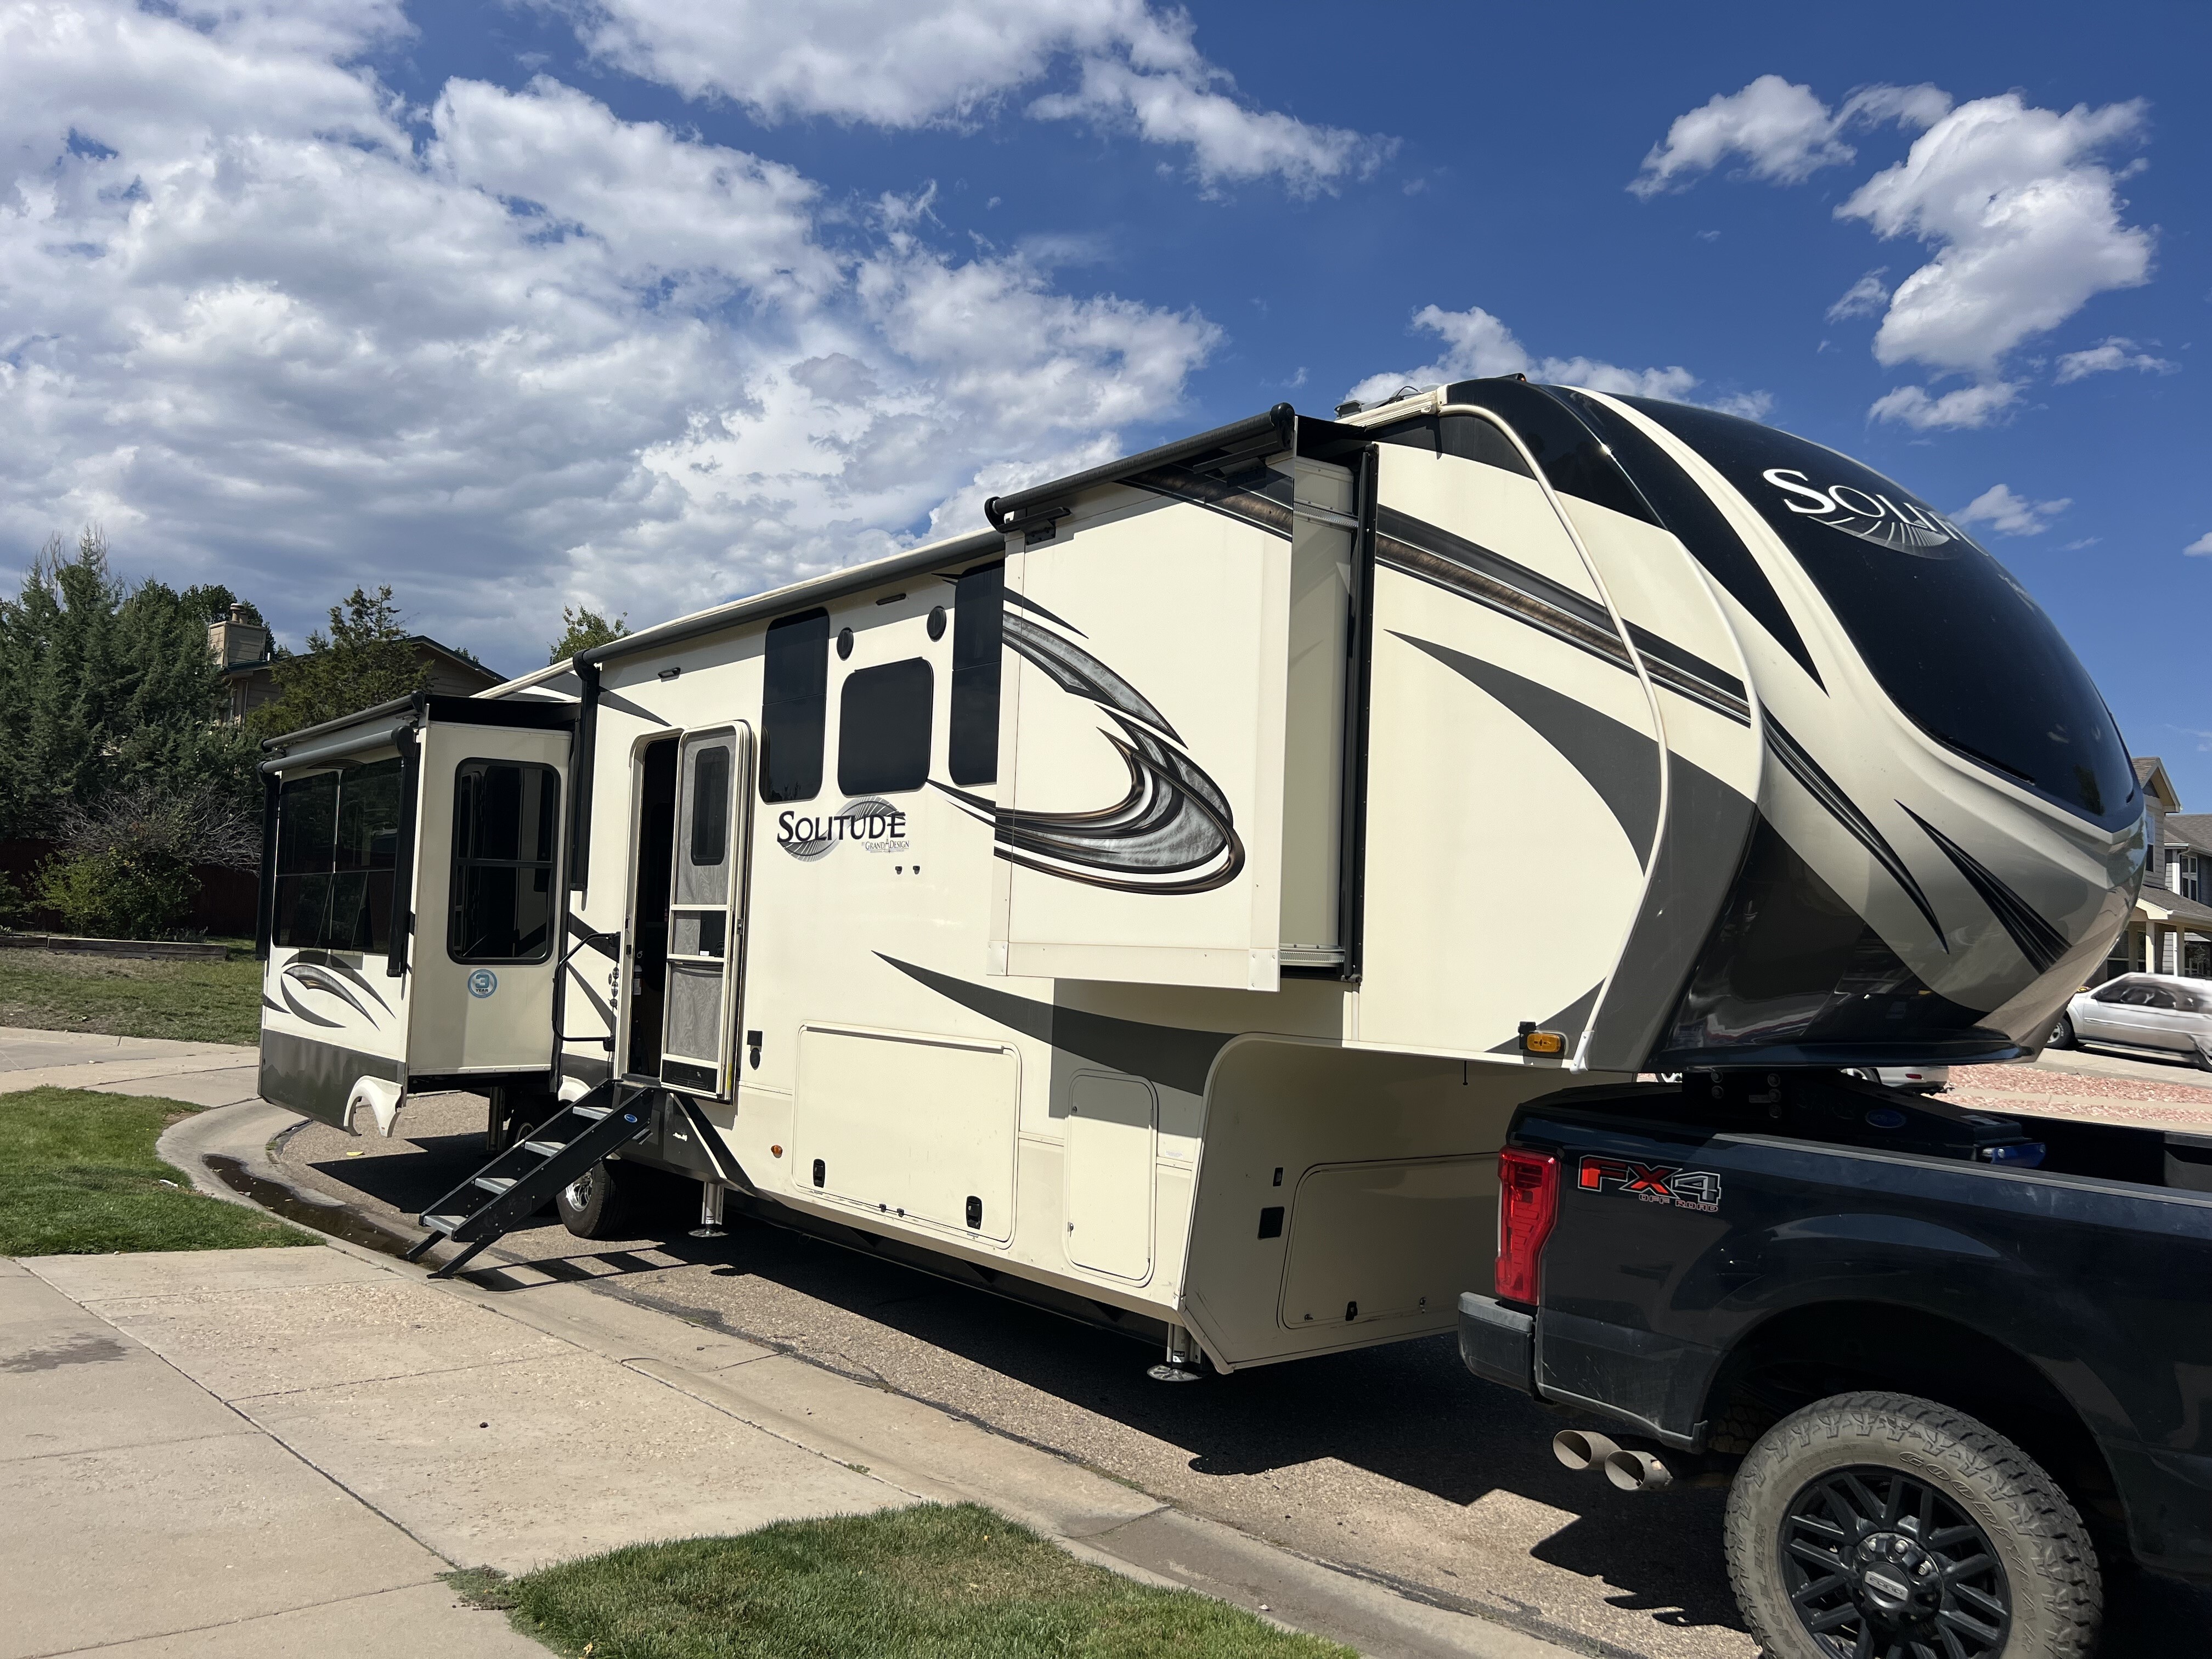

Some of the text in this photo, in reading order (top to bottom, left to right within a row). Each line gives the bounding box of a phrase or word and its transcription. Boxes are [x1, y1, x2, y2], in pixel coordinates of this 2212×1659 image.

[777, 810, 906, 843] SOLITUDE
[865, 841, 885, 850] GRAND
[889, 840, 910, 849] DESIGN
[475, 974, 490, 988] 3
[1578, 1154, 1721, 1205] FX4
[1639, 1193, 1718, 1212] OFF ROAD
[1898, 1451, 2036, 1652] GOODYEAR
[1869, 1577, 1904, 1596] FORD
